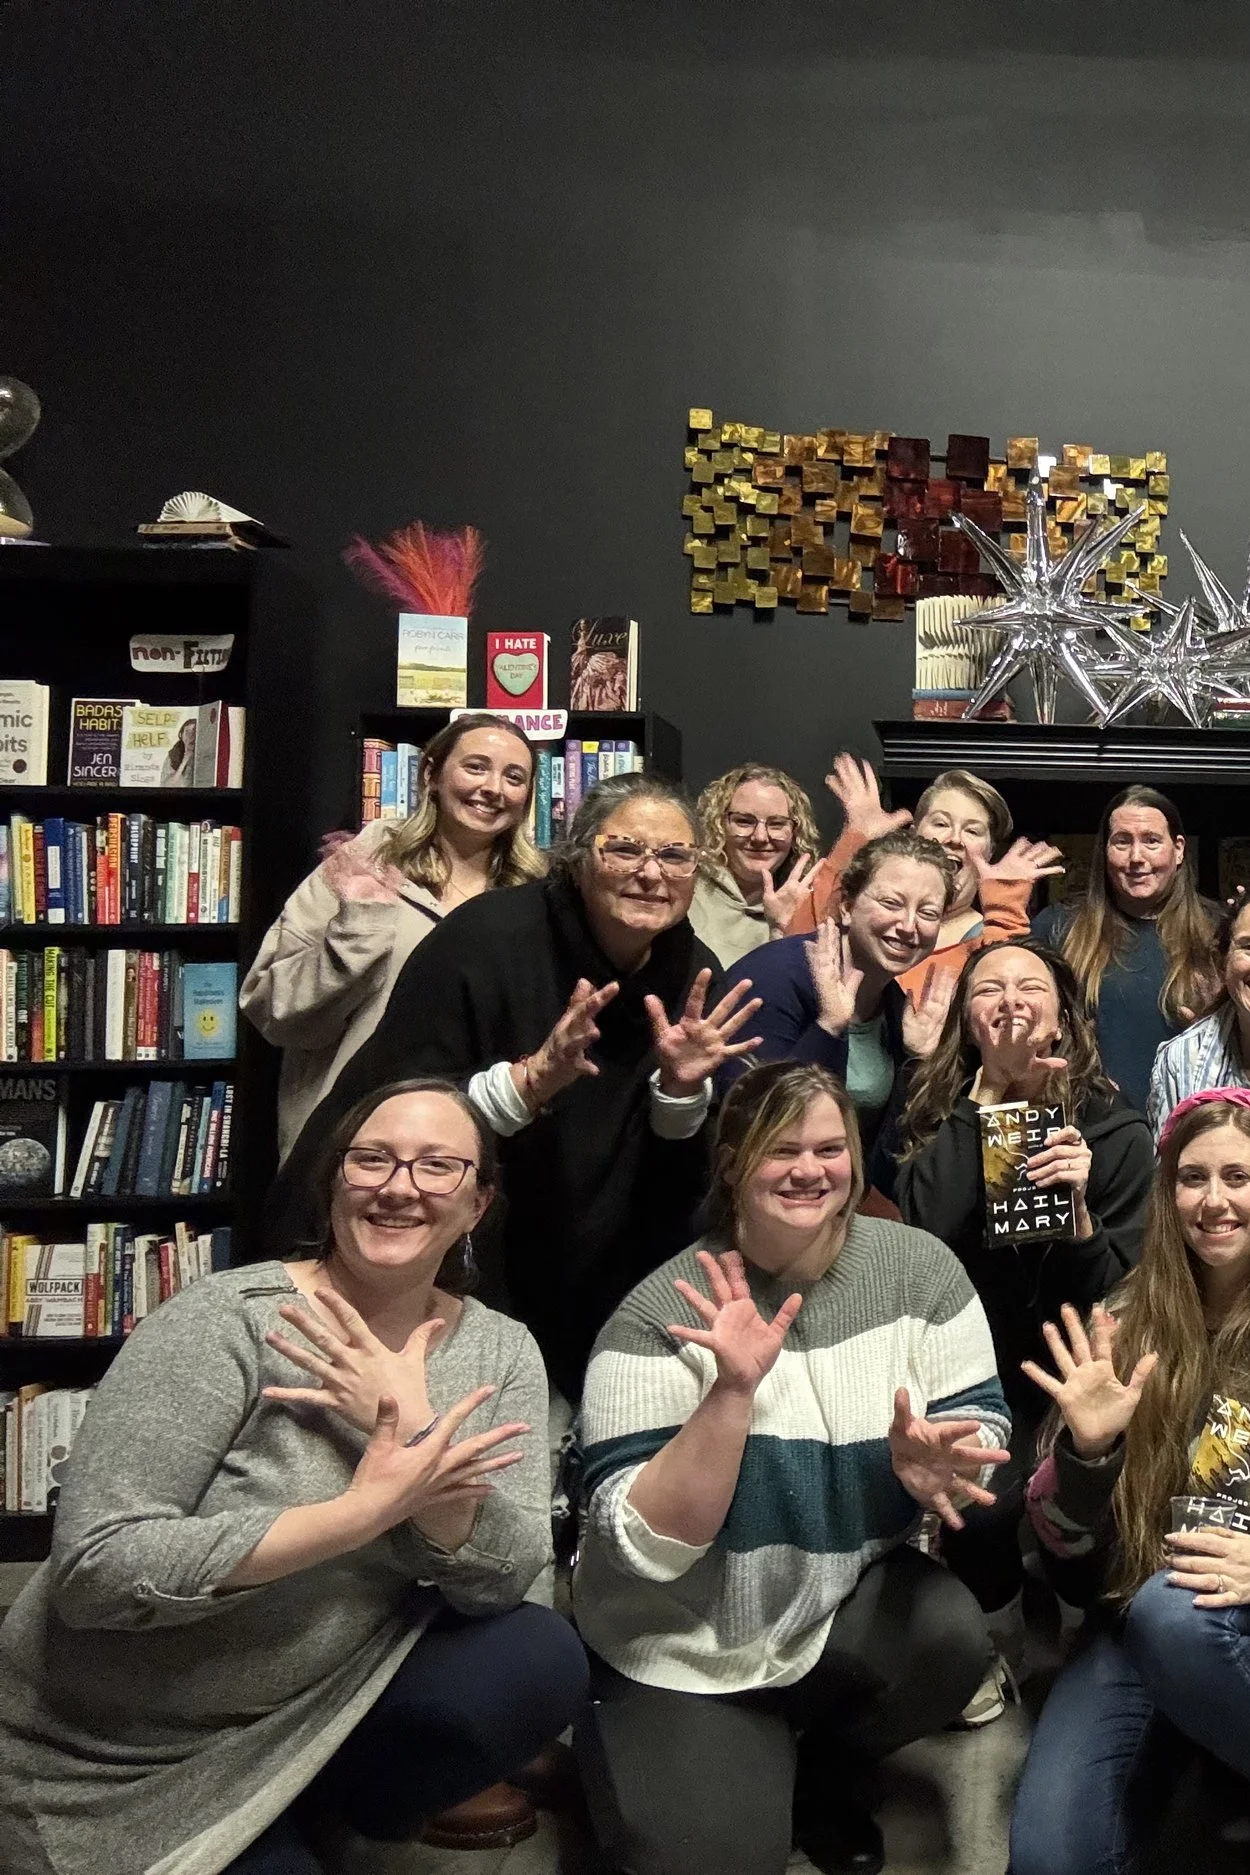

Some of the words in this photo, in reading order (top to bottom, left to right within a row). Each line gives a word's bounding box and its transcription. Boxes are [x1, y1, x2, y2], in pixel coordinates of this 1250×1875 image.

[495, 638, 500, 649] I
[505, 638, 537, 650] HATE
[76, 704, 123, 718] BADAS
[79, 718, 122, 731] HABIT
[91, 753, 113, 765] JEN
[73, 766, 122, 778] SINCER
[45, 948, 55, 976] MAKING
[45, 979, 55, 992] THE
[45, 994, 55, 1008] CUT
[17, 1009, 28, 1024] ONE
[225, 1085, 235, 1104] LOST
[223, 1105, 232, 1114] IN
[987, 1107, 1059, 1127] ANDY
[218, 1115, 232, 1159] SHANGRI-LA
[993, 1194, 1069, 1214] HAIL
[994, 1212, 1070, 1235] MARY
[29, 1282, 80, 1293] WOLFPACK
